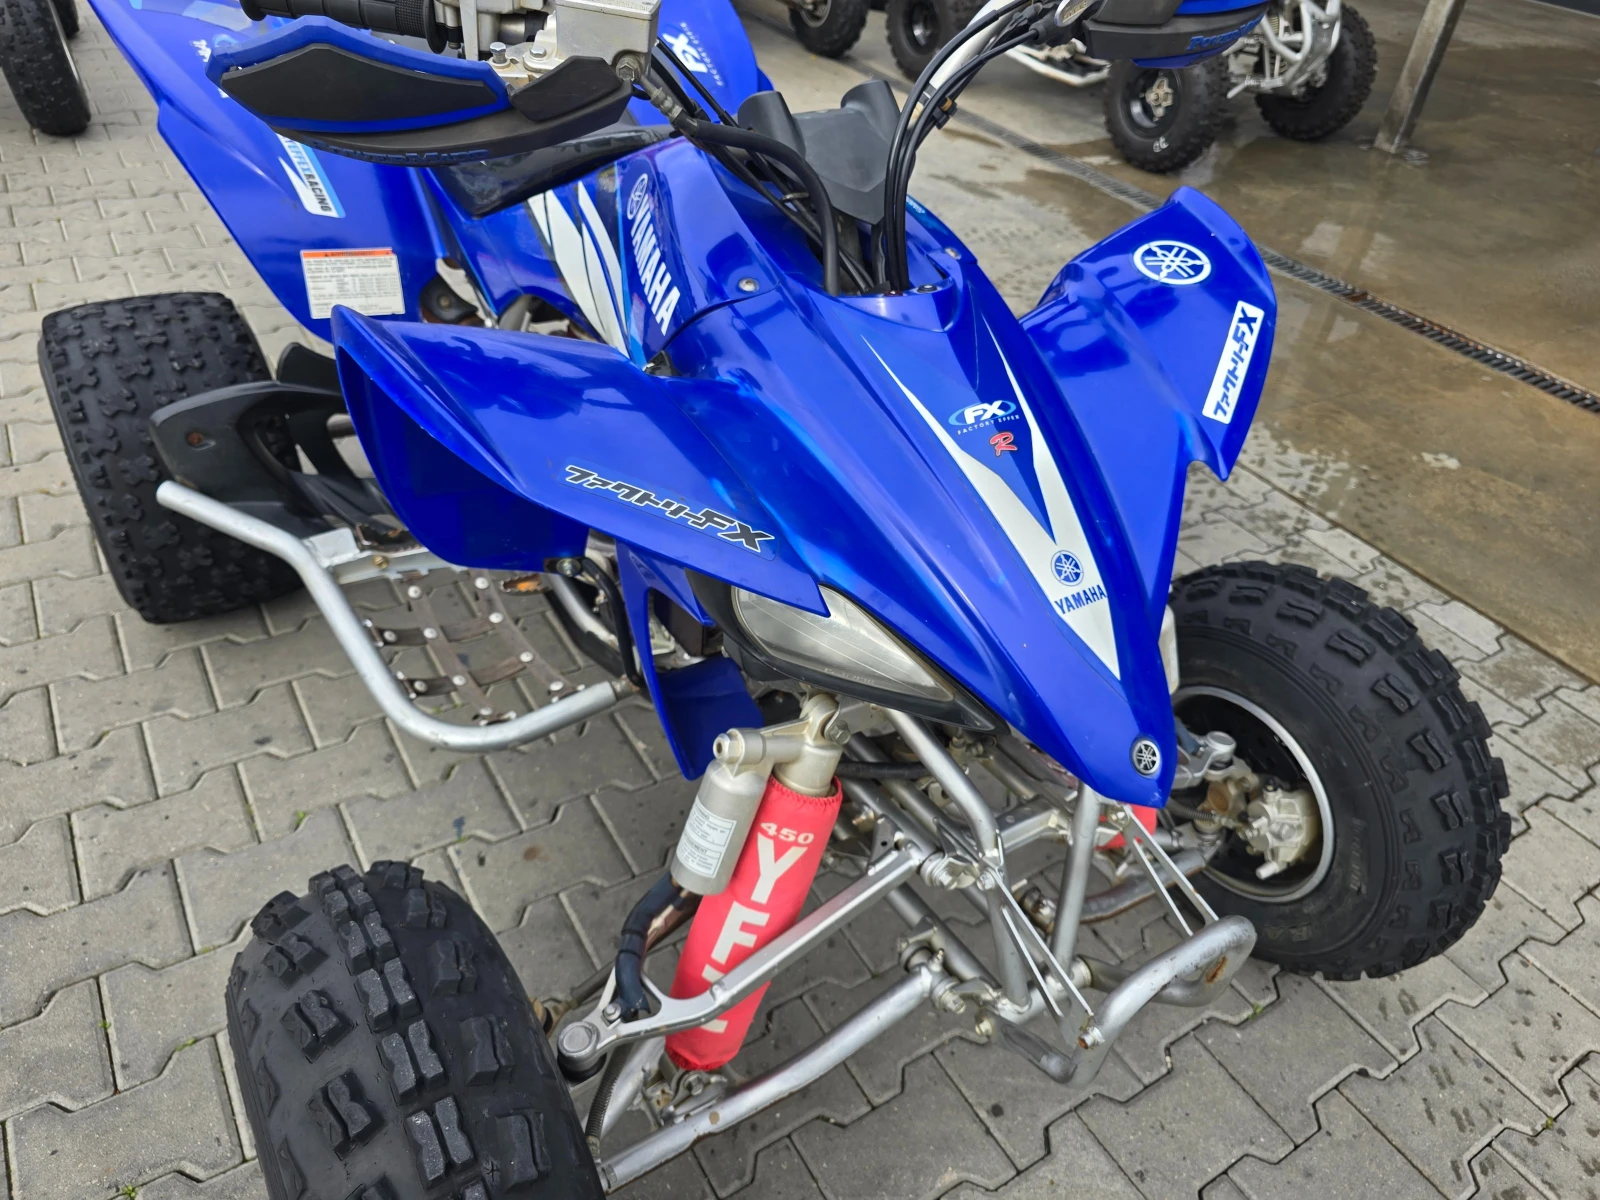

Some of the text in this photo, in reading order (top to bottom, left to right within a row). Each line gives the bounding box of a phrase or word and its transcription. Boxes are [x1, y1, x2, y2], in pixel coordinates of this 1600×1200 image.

[662, 33, 708, 73] FX
[631, 193, 681, 336] YAMAHA
[957, 414, 1020, 435] FACTORY EFFEX
[964, 400, 1006, 425] FX
[989, 432, 1018, 457] R
[1054, 584, 1107, 615] YAMAHA
[760, 822, 815, 845] 450
